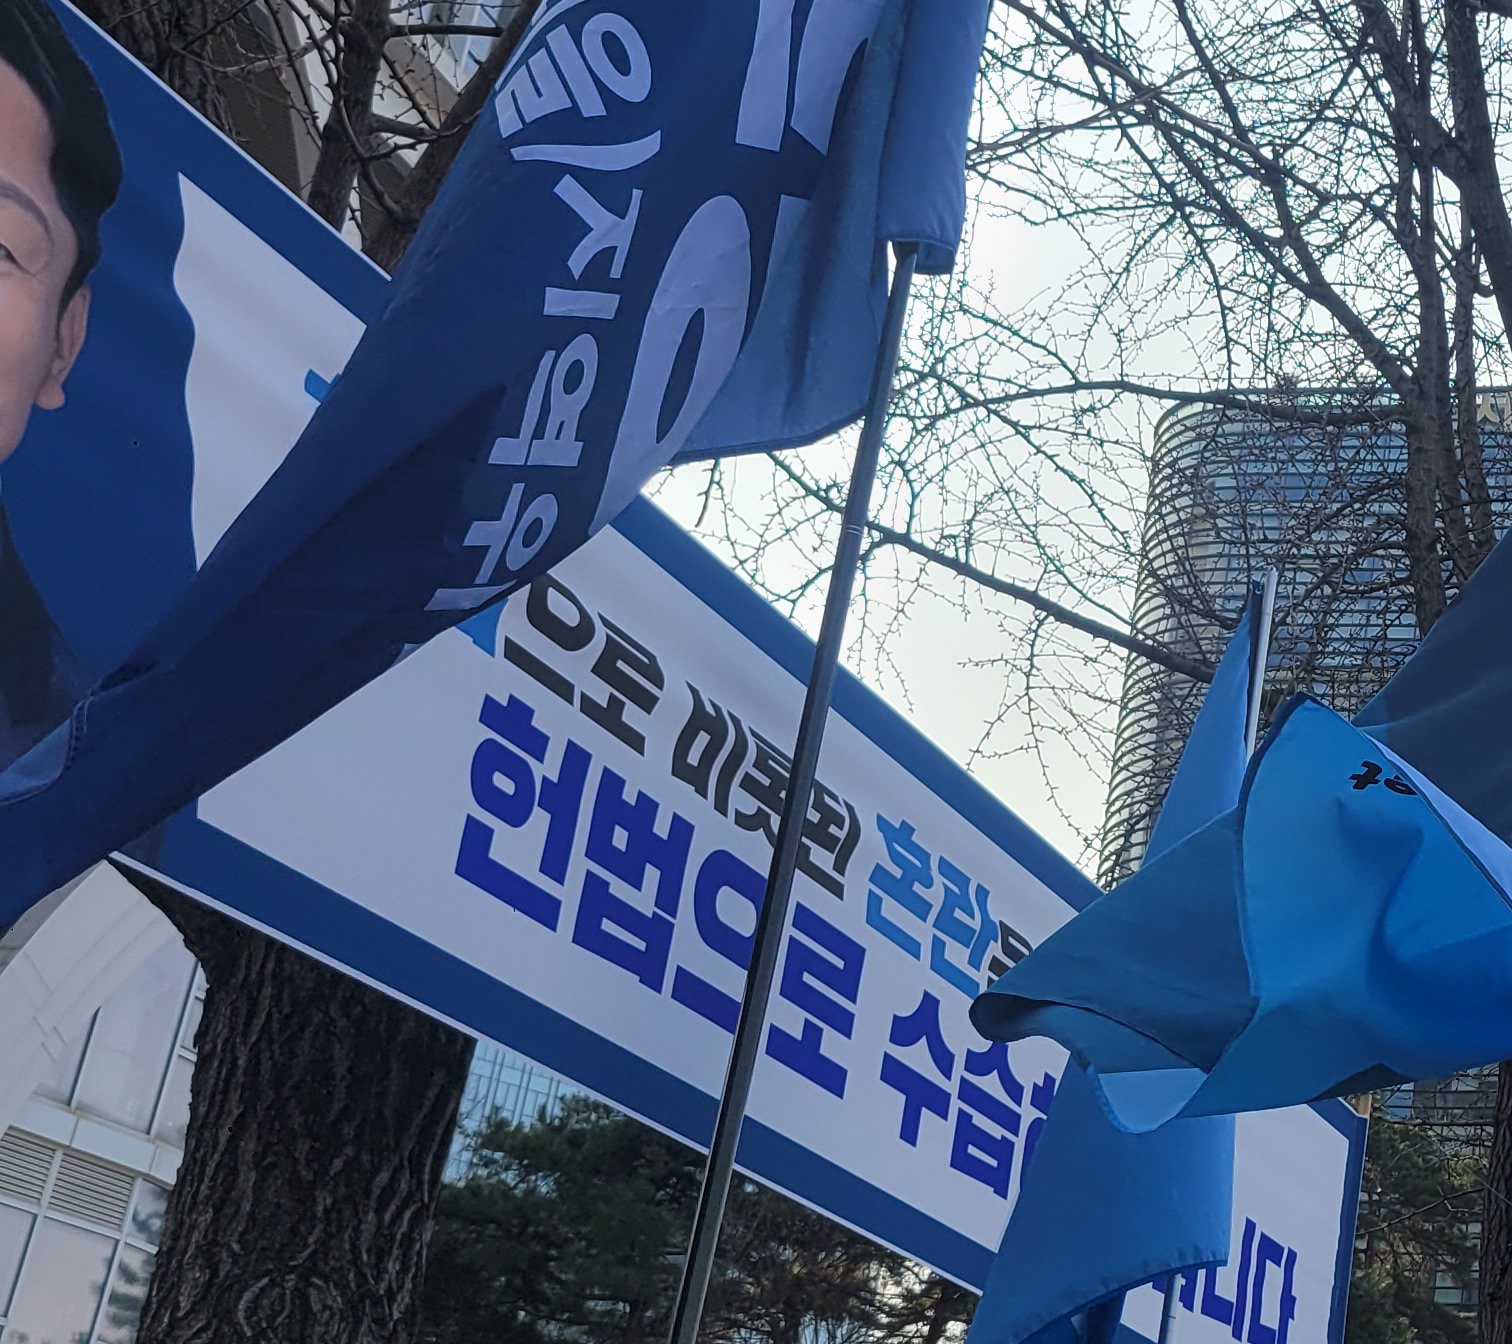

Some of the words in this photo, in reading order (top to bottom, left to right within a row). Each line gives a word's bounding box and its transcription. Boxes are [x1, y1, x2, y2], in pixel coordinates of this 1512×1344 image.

[454, 692, 867, 1100] 헌법으로
[457, 574, 665, 757] 으로
[671, 678, 863, 902] 비롯된
